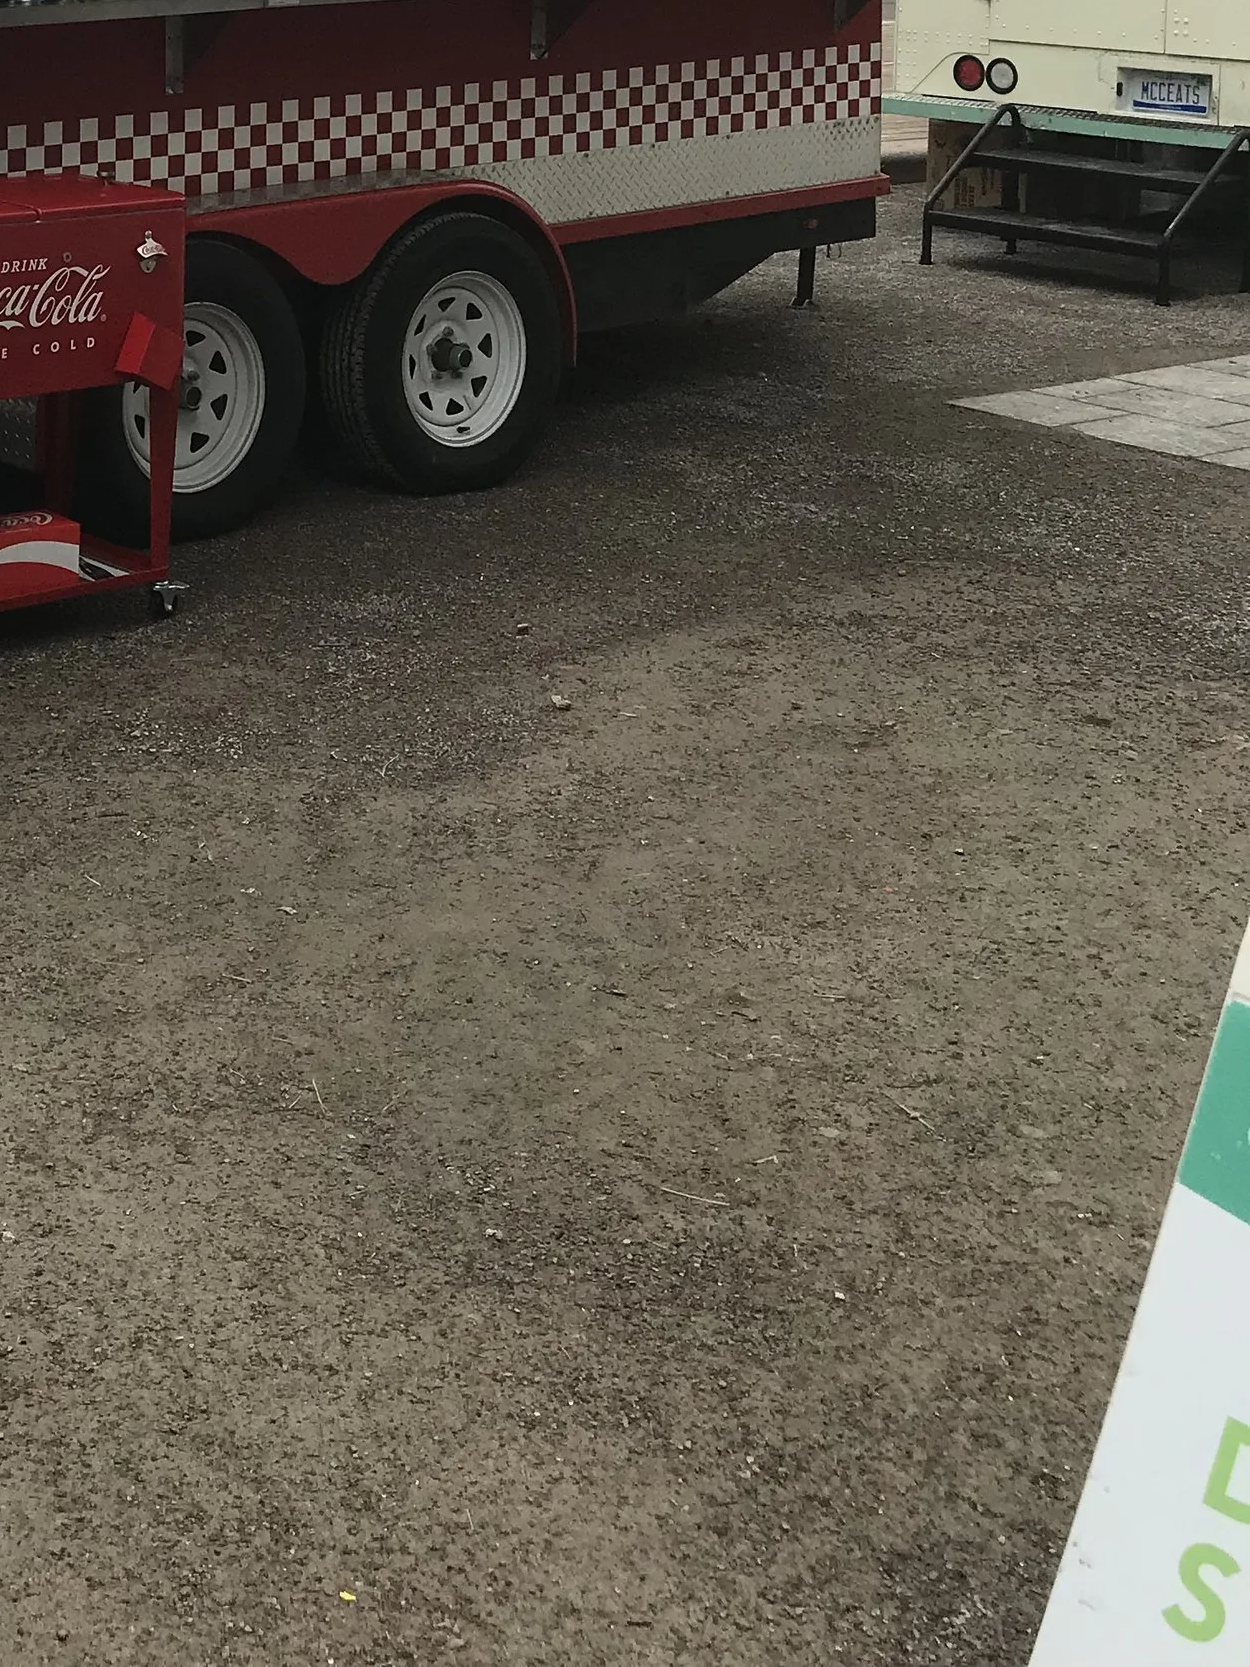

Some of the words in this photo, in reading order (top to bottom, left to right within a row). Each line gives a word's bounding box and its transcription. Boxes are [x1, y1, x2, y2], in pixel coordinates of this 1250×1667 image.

[1141, 81, 1200, 105] MCCEATS
[0, 257, 48, 274] DRINK
[32, 337, 95, 355] COLD
